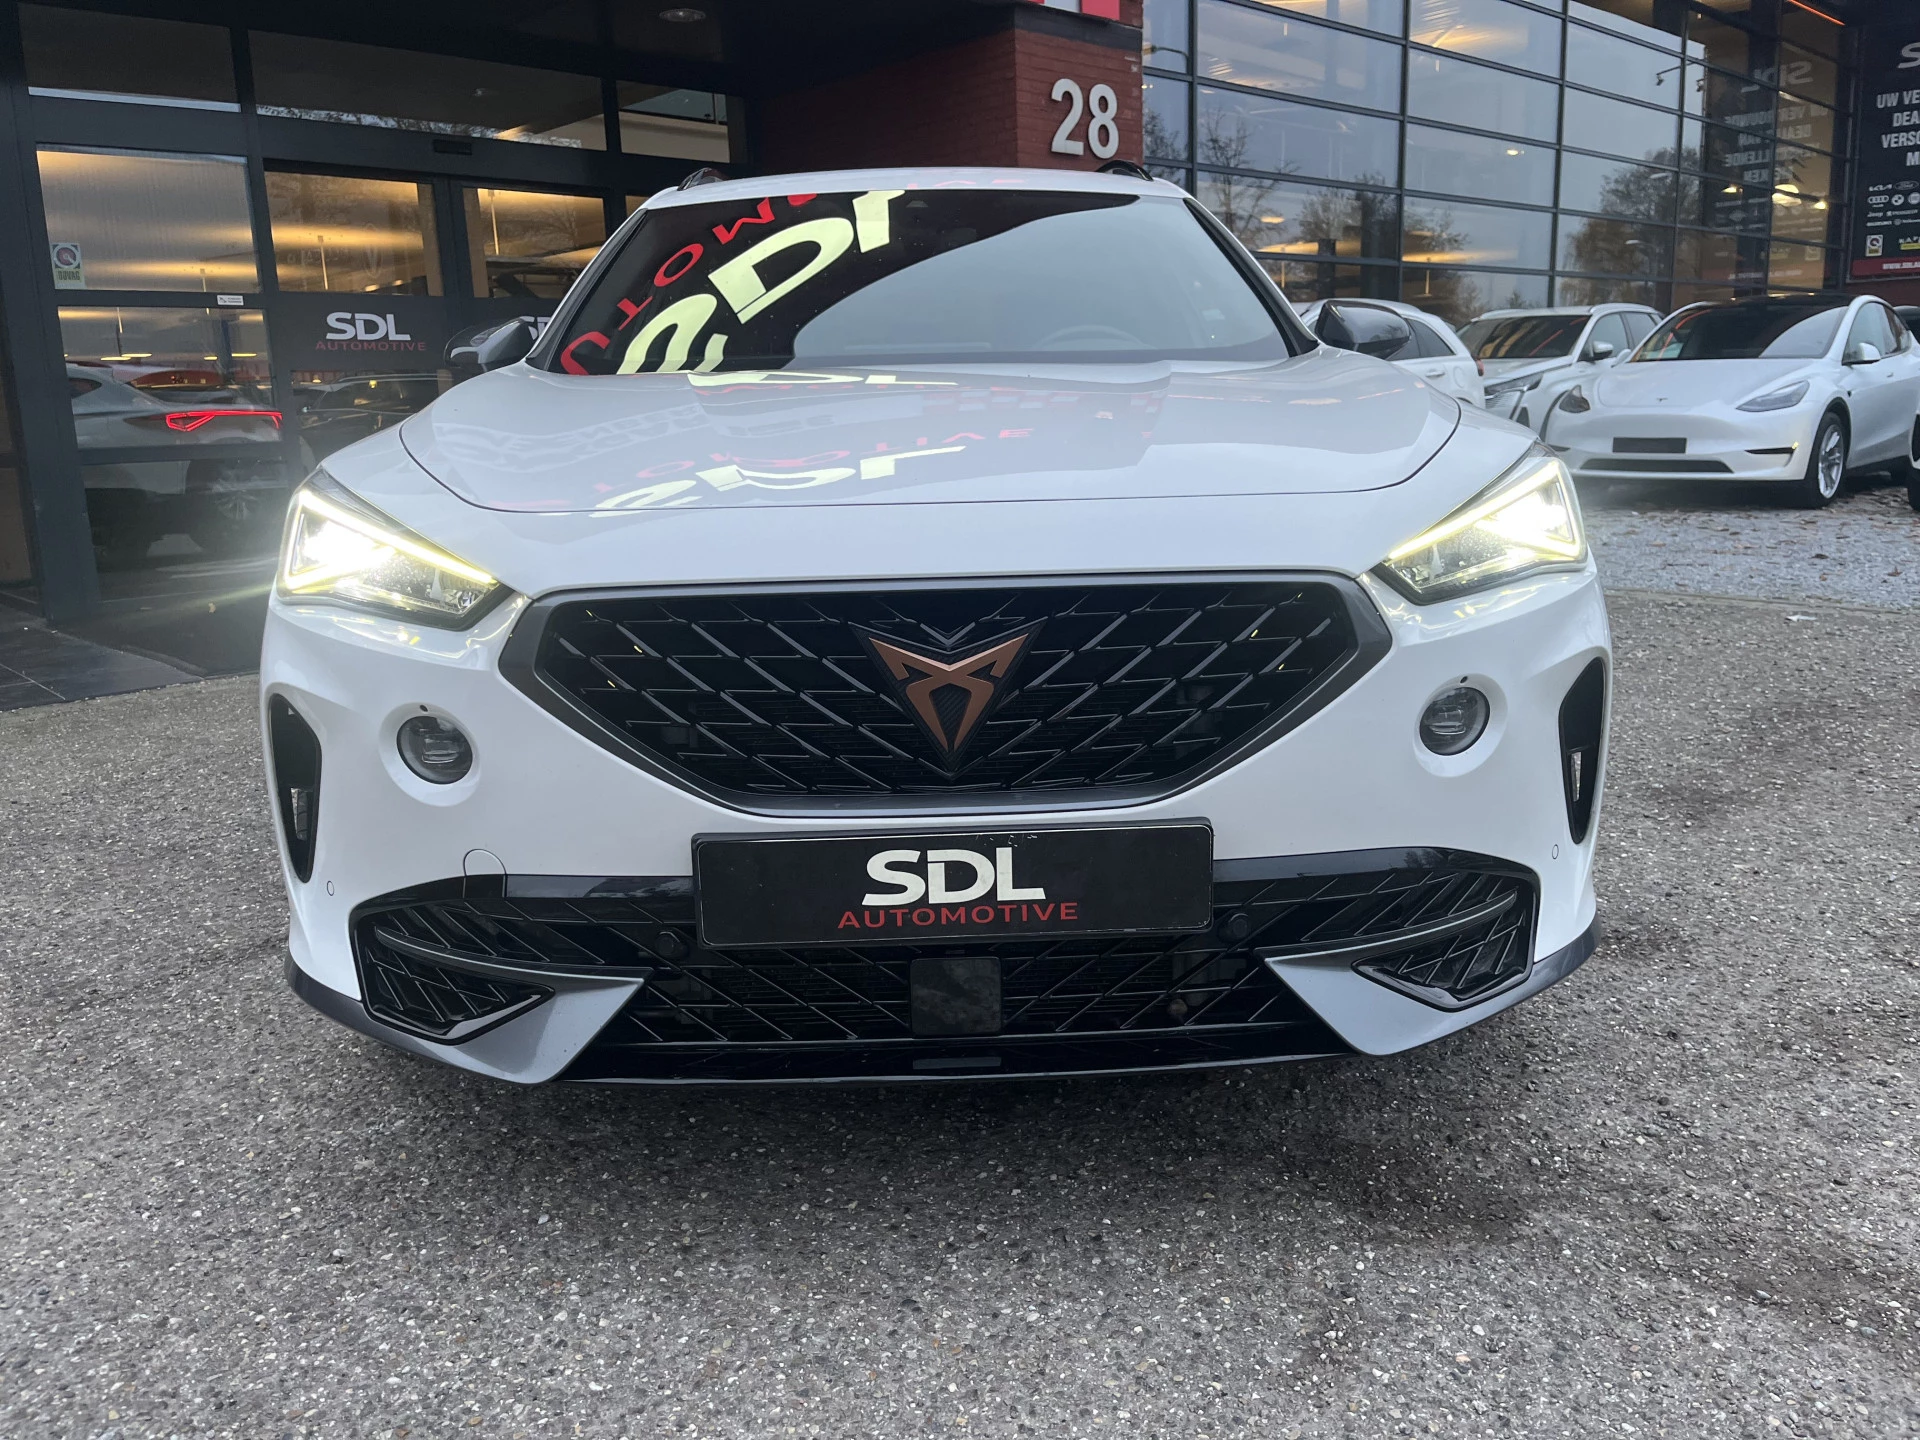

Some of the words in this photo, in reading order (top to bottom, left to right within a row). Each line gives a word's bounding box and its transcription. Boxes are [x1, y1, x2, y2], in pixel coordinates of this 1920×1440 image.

[1877, 92, 1899, 108] UW
[1051, 78, 1119, 159] 28
[326, 311, 411, 341] SDL
[315, 340, 427, 351] AUTOMOTIVE
[861, 847, 1047, 906] SDL
[836, 902, 1079, 929] AUTOMOTIVE
